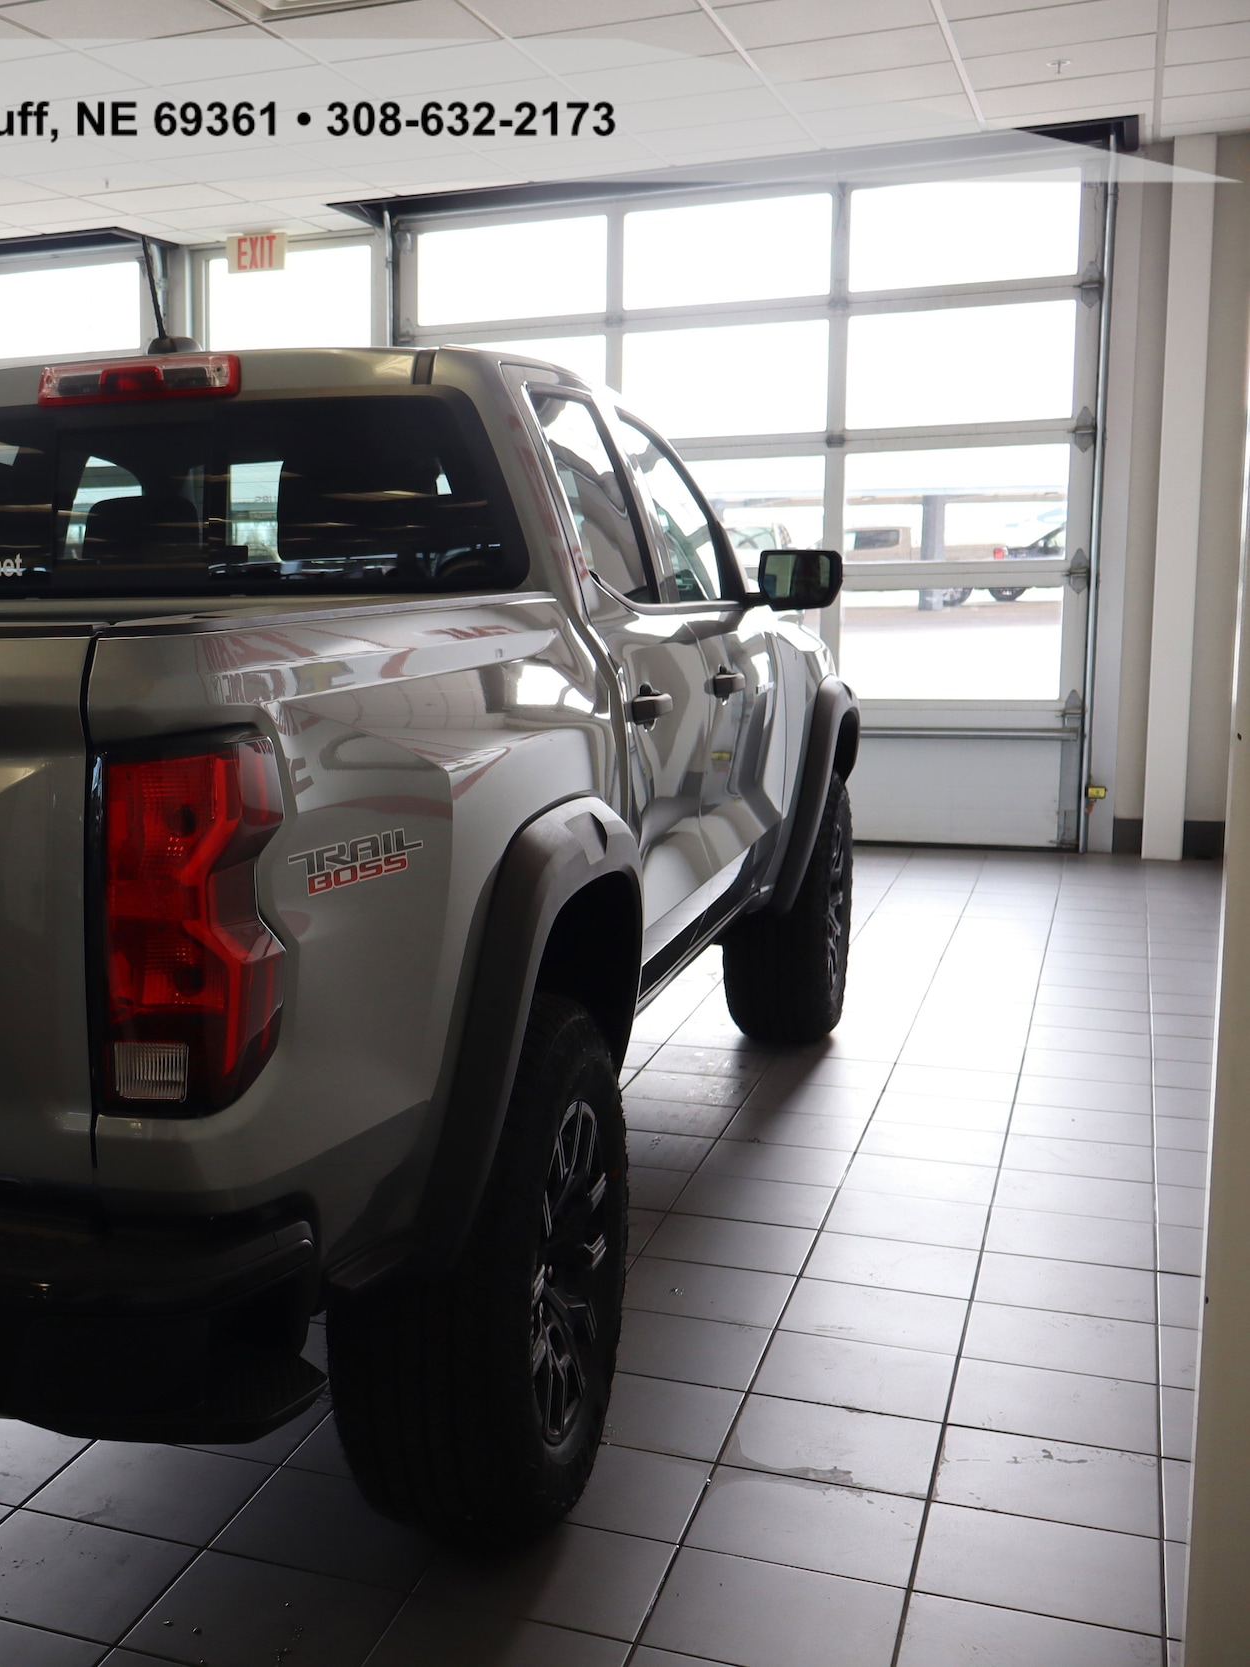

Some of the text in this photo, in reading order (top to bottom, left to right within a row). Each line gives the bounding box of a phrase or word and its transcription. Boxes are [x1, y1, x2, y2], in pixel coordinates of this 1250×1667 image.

[237, 235, 277, 271] EXIT
[288, 828, 424, 876] TRAIL
[307, 852, 409, 897] BOSS
